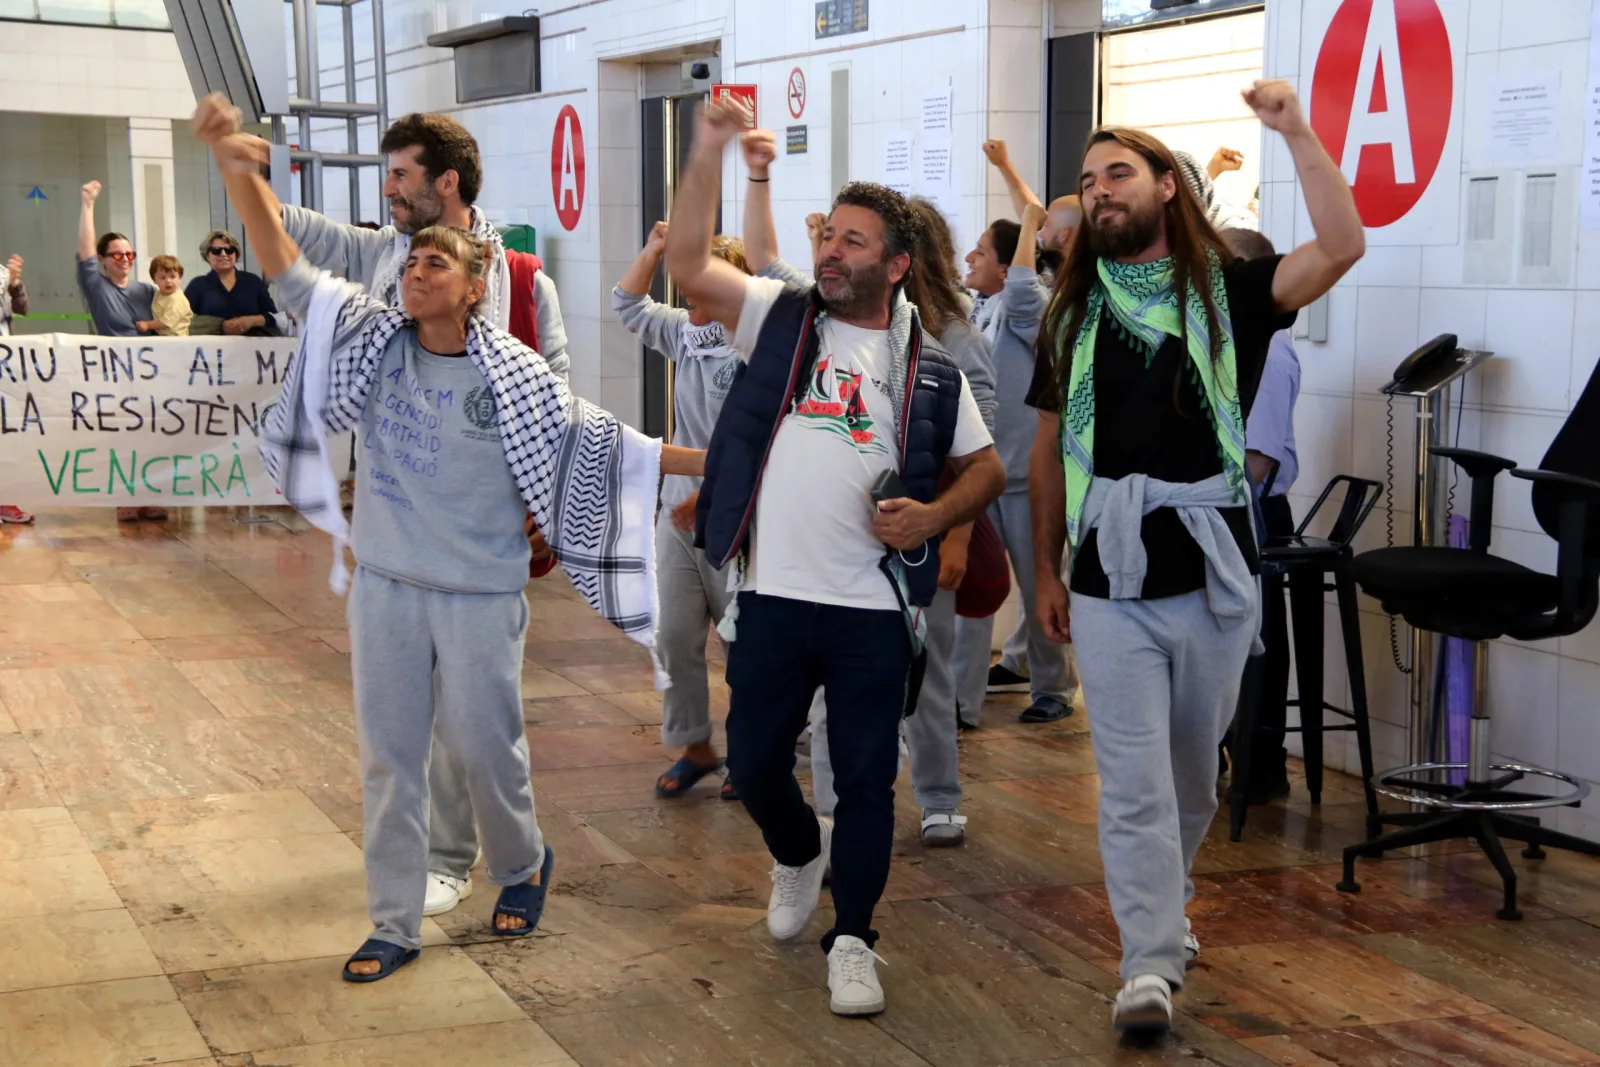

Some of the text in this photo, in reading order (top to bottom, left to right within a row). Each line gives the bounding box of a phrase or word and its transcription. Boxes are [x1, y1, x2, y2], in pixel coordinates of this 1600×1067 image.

[1336, 0, 1416, 187] A
[558, 115, 579, 211] A
[0, 343, 56, 383] RIU
[80, 345, 159, 383] FINS
[188, 346, 235, 386] AL
[1, 391, 44, 436] LA
[37, 442, 250, 498] VENCERÀ
